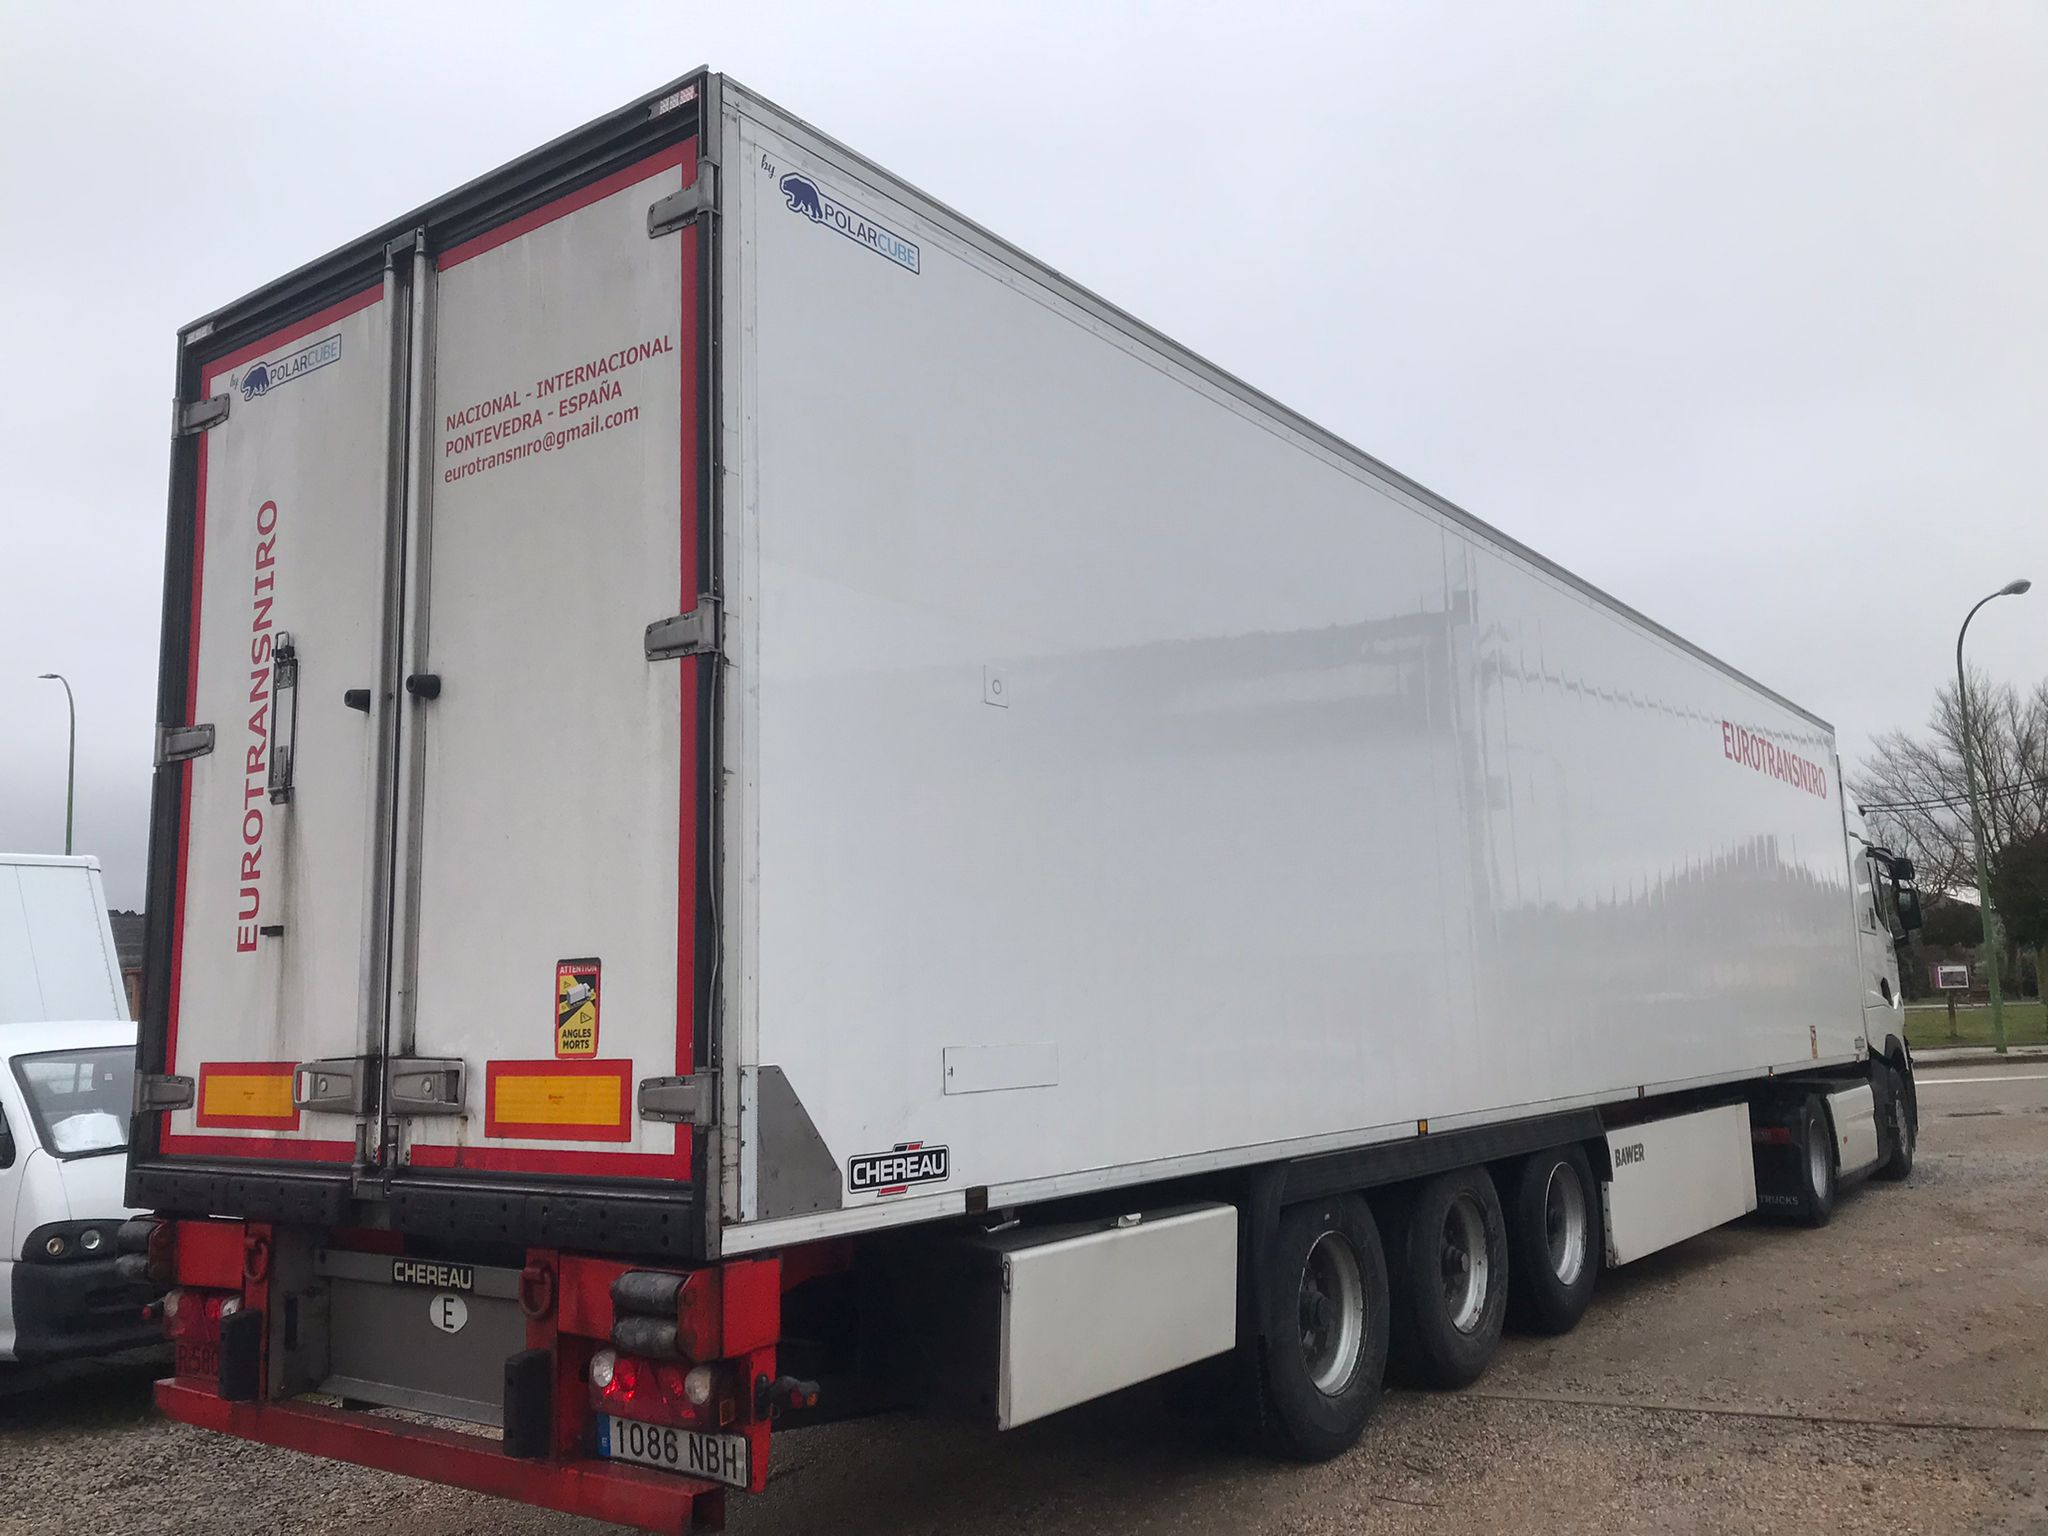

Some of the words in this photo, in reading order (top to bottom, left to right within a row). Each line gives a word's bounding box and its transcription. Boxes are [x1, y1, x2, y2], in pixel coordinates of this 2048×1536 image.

[761, 153, 776, 179] by
[825, 203, 915, 267] POLARCUBE
[270, 341, 338, 384] POLARCUBE
[446, 391, 521, 432] NACIONAL
[536, 336, 673, 399] INTERNACIONAL
[445, 409, 543, 457] PONTEVEDRA
[559, 379, 623, 417] ESPAÑA
[236, 500, 278, 953] EUROTRANSNIRO
[1722, 720, 1827, 801] EUROTRANSNIRO
[562, 1029, 591, 1038] ANGLES
[563, 1040, 590, 1049] MORTS
[853, 1153, 945, 1186] CHEREAU
[1615, 1142, 1645, 1168] BAWER
[394, 1262, 472, 1290] CHEREAU
[443, 1297, 455, 1329] E
[616, 1420, 679, 1464] 1086
[689, 1433, 737, 1479] NBH
